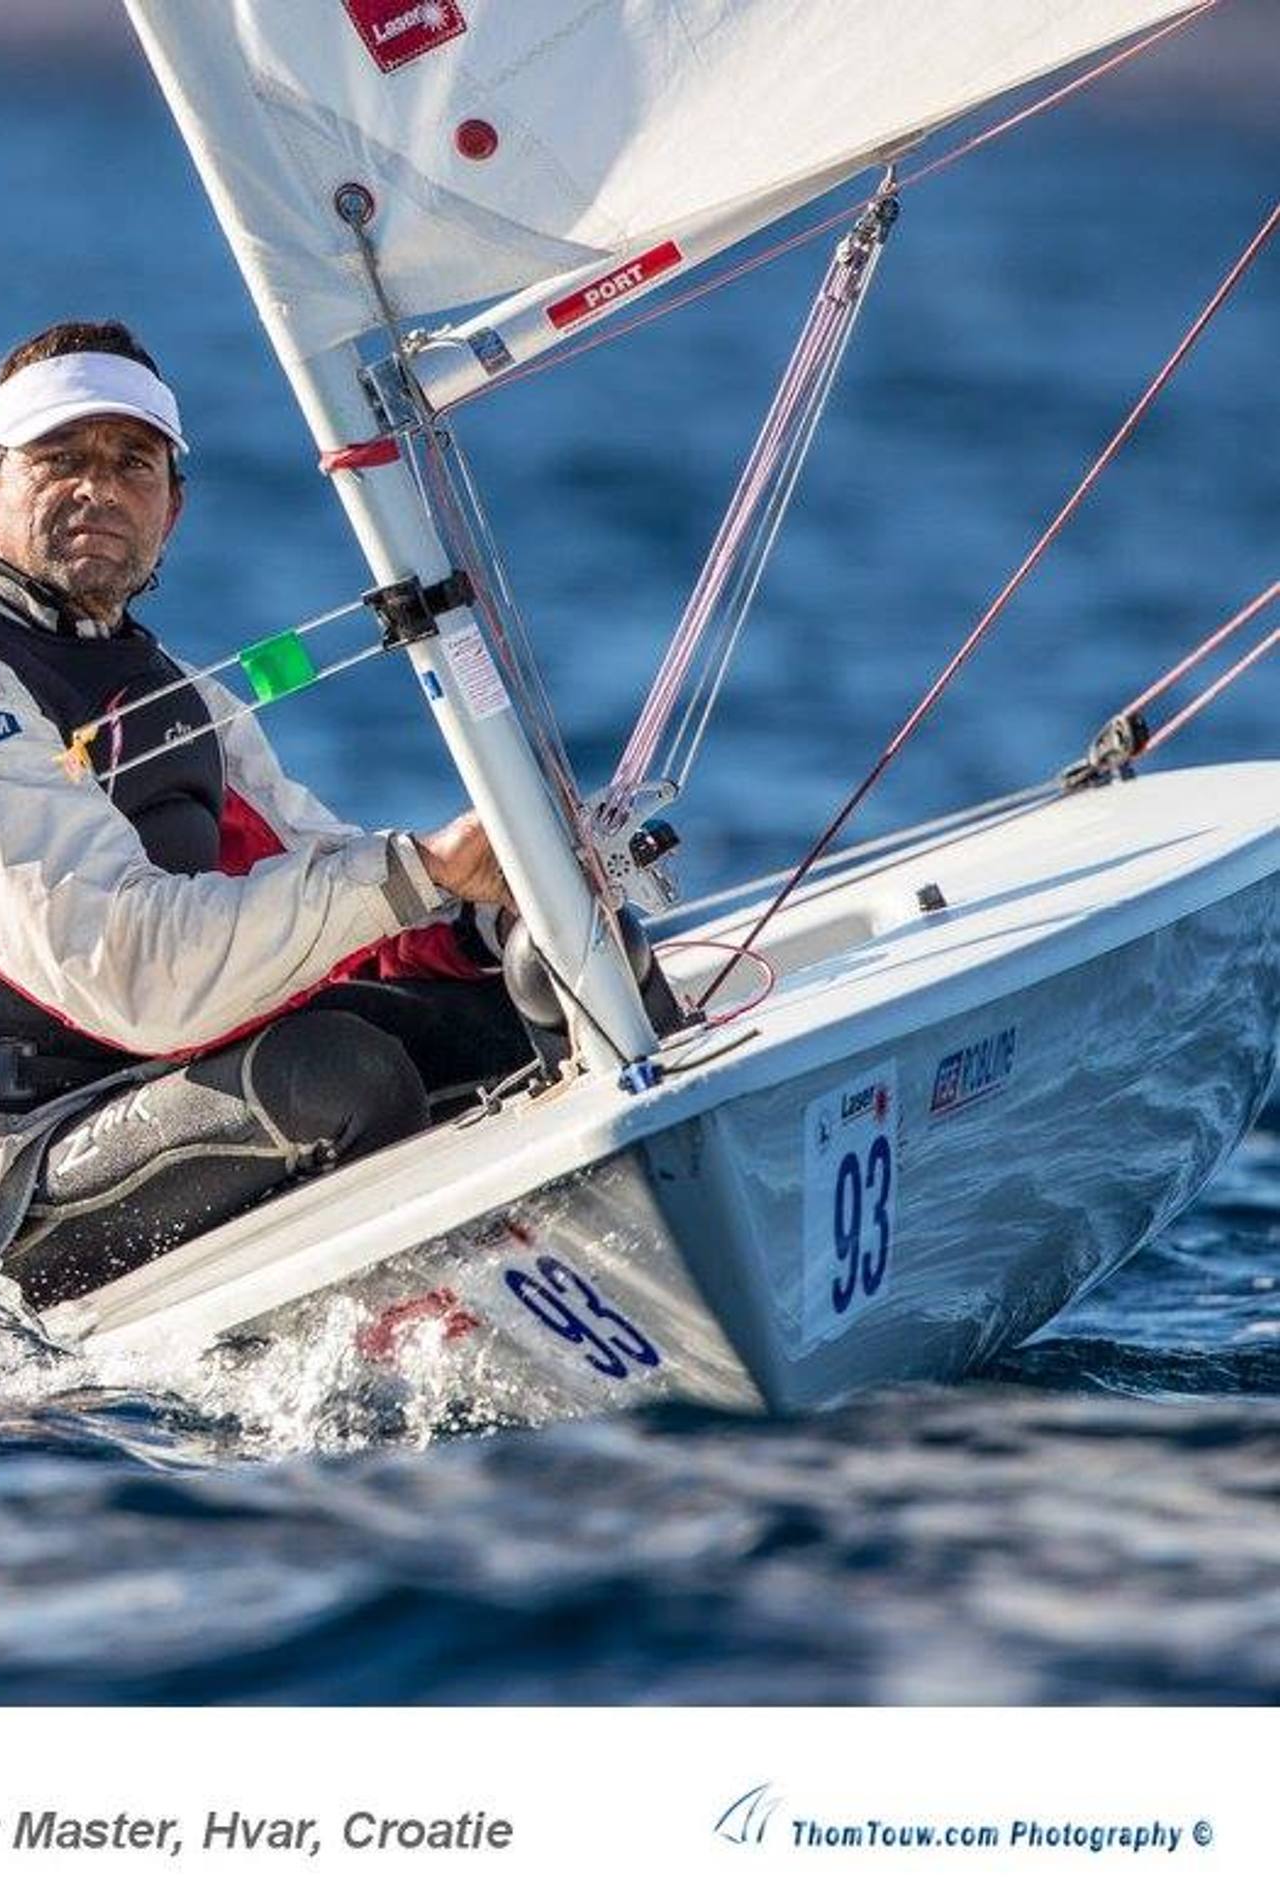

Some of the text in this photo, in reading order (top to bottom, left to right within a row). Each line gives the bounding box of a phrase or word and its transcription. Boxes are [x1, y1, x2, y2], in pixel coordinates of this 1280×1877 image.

[584, 264, 643, 308] PORT
[841, 1086, 874, 1118] Laser
[831, 1134, 892, 1315] 93
[504, 1255, 660, 1380] 93
